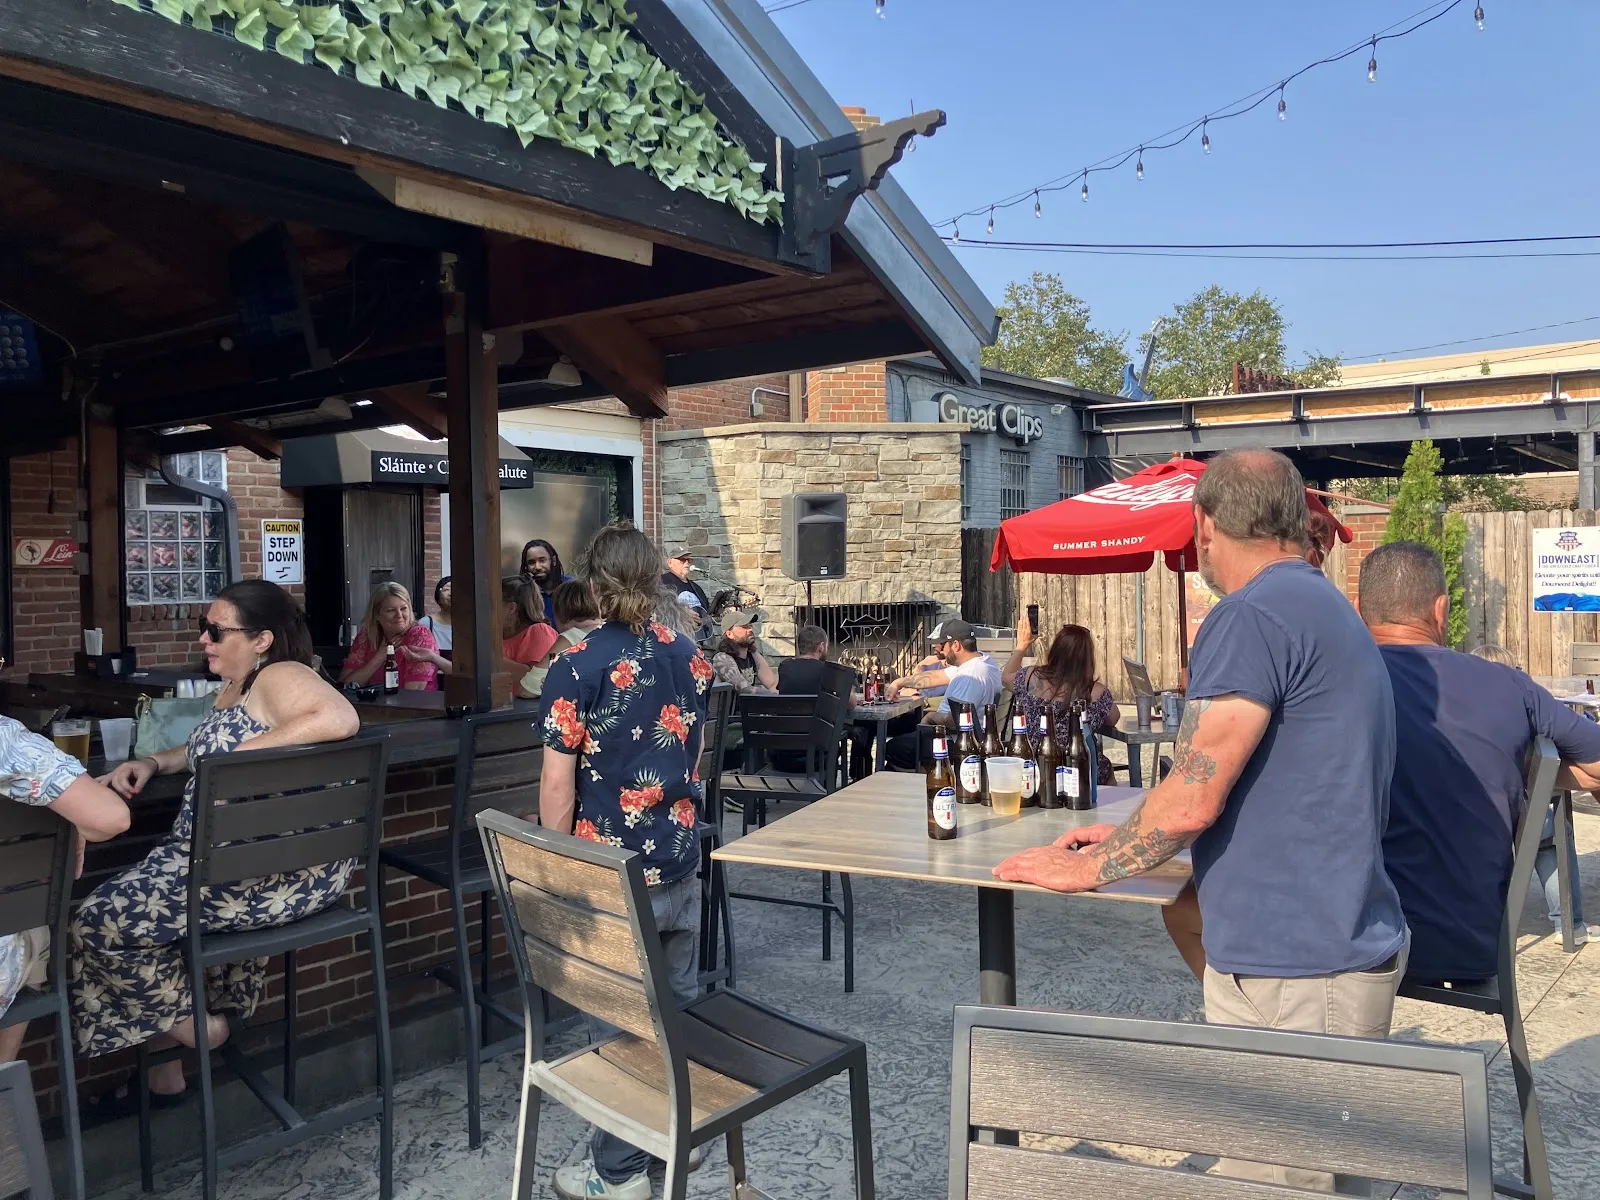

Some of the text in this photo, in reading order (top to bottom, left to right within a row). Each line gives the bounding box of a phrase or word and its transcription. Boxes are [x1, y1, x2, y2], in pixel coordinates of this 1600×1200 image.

[940, 394, 1043, 443] Great Clips
[379, 457, 426, 473] Sláinte
[498, 464, 527, 479] alute
[265, 524, 299, 532] CAUTION
[269, 537, 295, 548] STEP
[1053, 536, 1144, 550] SUMMER SHANDY
[267, 551, 298, 562] DOWN
[1541, 554, 1596, 564] DOWNEAST
[587, 1177, 606, 1196] N
